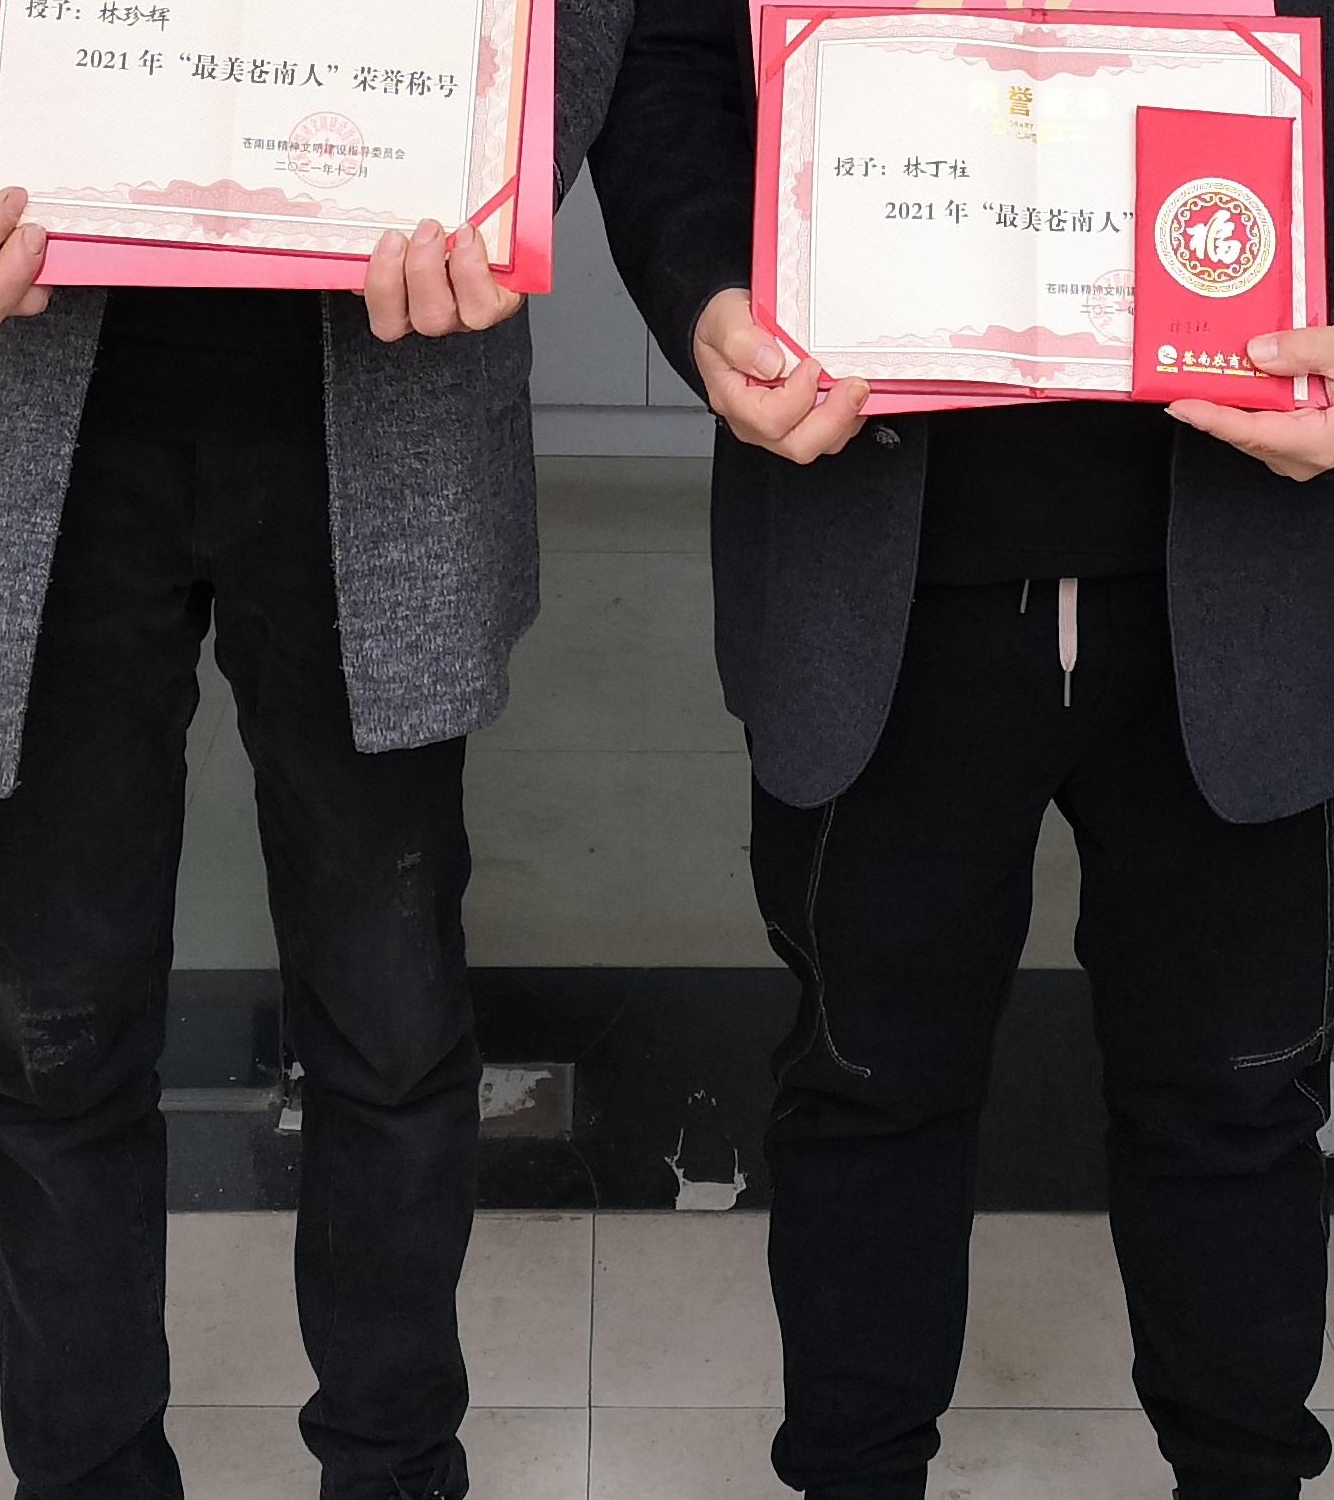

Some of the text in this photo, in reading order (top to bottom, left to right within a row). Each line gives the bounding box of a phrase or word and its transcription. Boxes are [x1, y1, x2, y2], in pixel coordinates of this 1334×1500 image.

[98, 2, 171, 32] 林珍辉
[352, 66, 459, 100] 荣誉称号
[1187, 211, 1243, 266] 福
